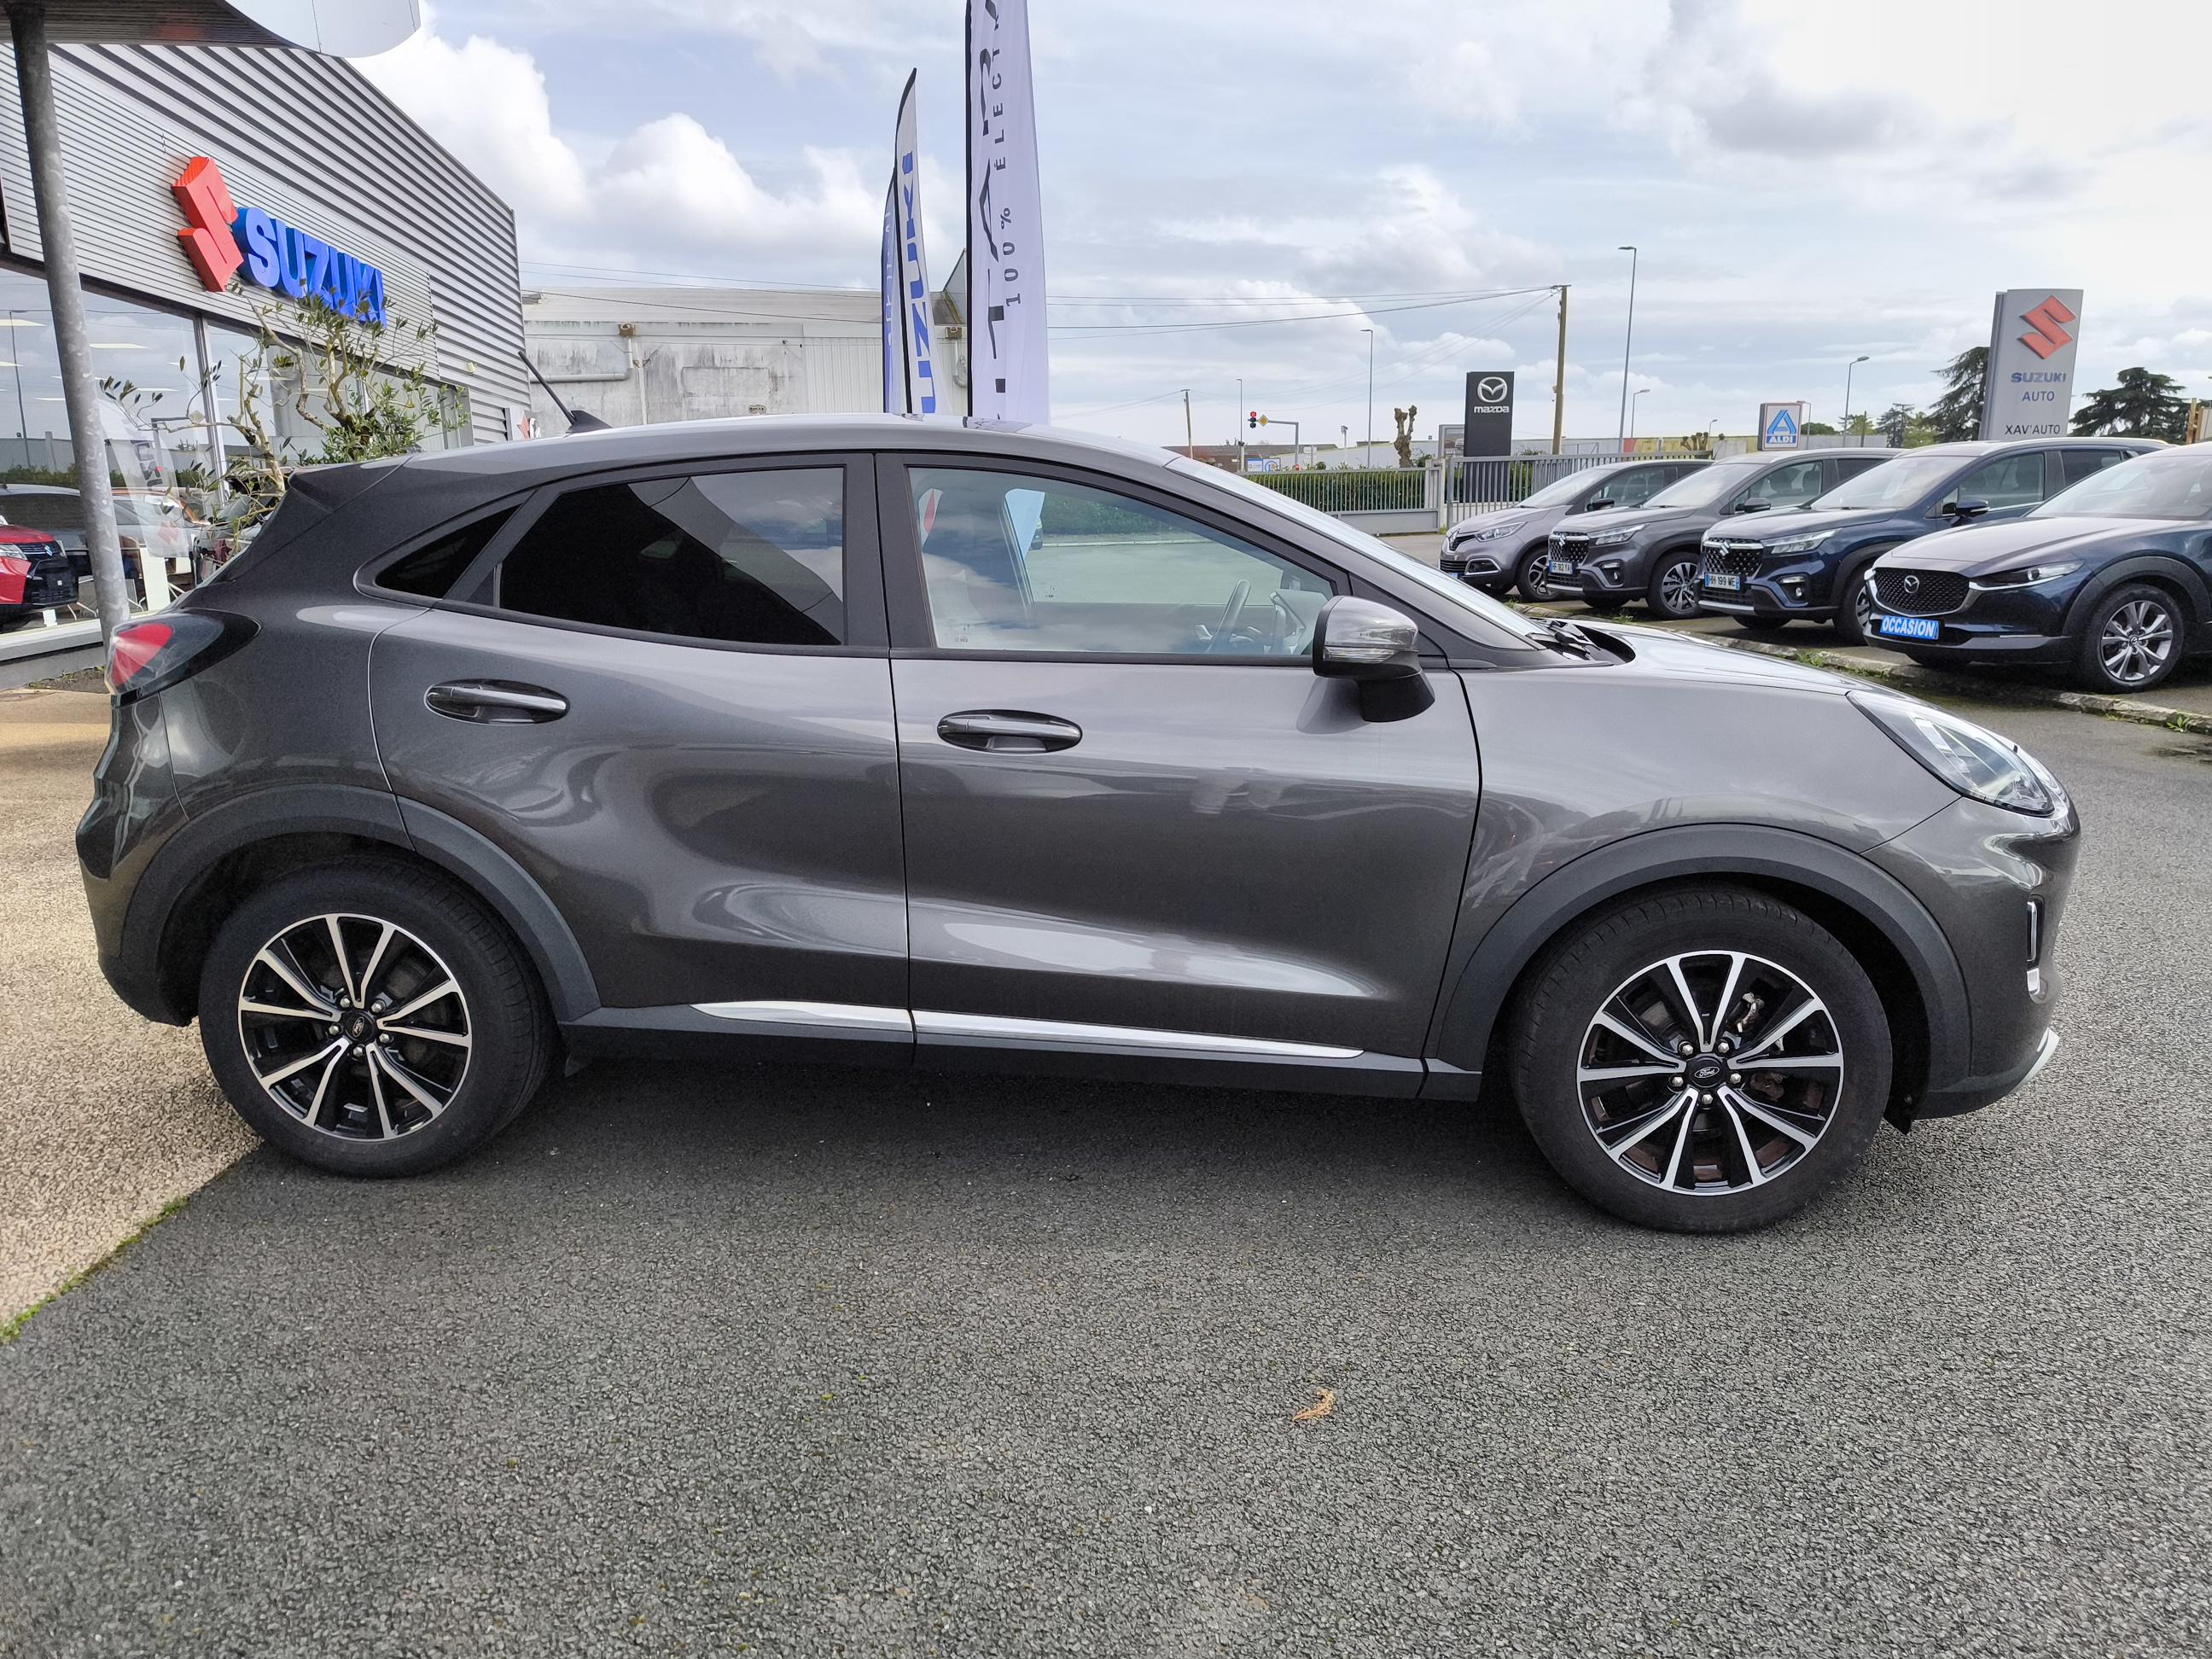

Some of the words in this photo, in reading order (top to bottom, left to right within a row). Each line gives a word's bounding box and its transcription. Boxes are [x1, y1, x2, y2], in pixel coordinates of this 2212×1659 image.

[234, 207, 387, 329] SUZUKI
[901, 151, 936, 414] UZUKI
[2010, 371, 2067, 383] SUZUKI
[2021, 391, 2055, 402] AUTO
[1473, 405, 1510, 414] mazda
[2004, 424, 2061, 435] XAV'AUTO
[1767, 435, 1794, 444] ALDI
[1881, 615, 1935, 637] OCCASION
[1698, 1068, 1716, 1077] Ford
